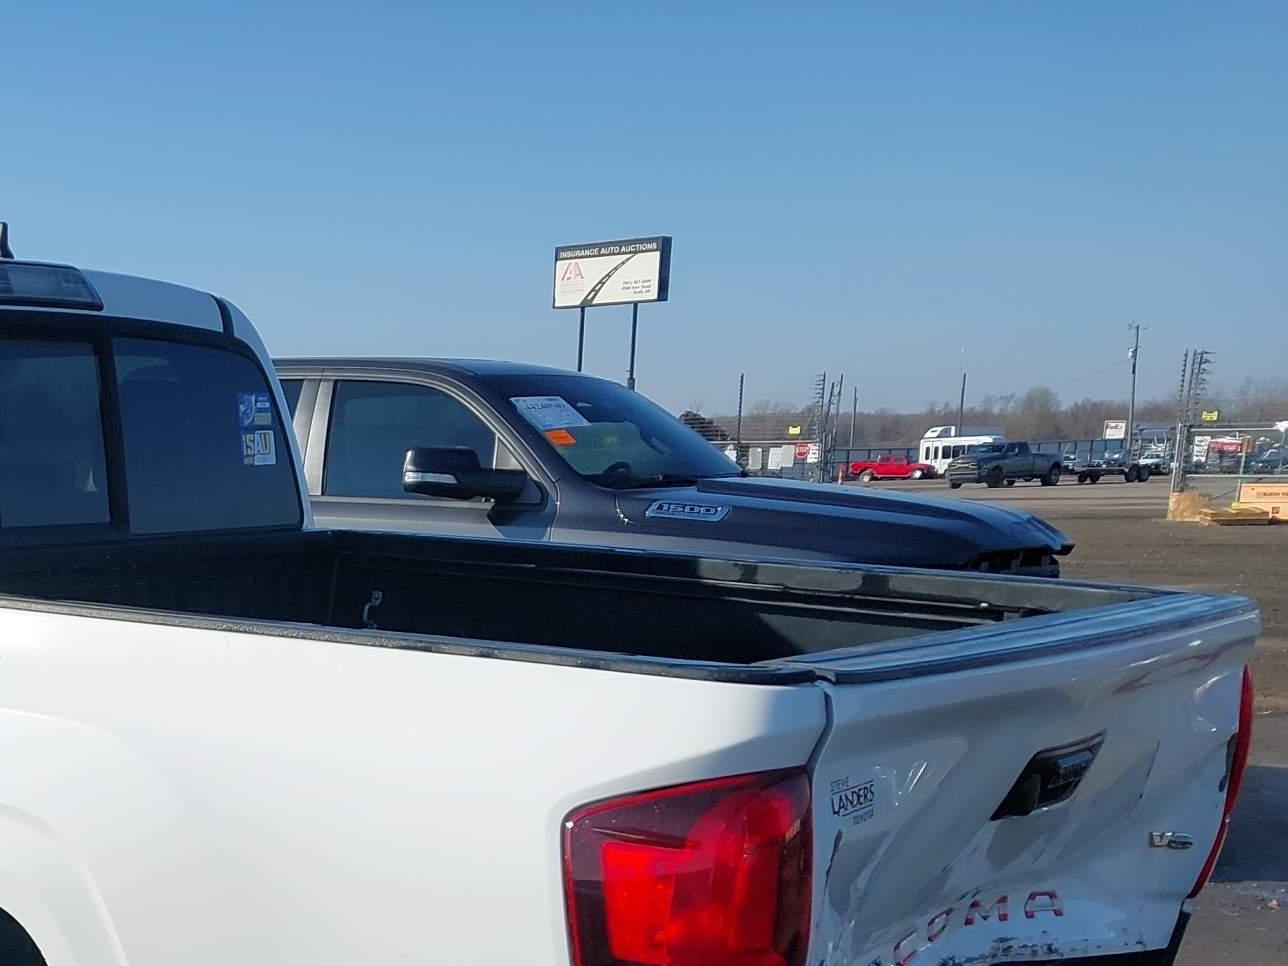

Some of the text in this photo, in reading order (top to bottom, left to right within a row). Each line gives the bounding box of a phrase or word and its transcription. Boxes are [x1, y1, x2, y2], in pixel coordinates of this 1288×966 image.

[559, 242, 658, 259] INSURANCE AUTO AUCTIONS
[660, 503, 717, 515] 1500
[831, 783, 875, 816] LANDERS
